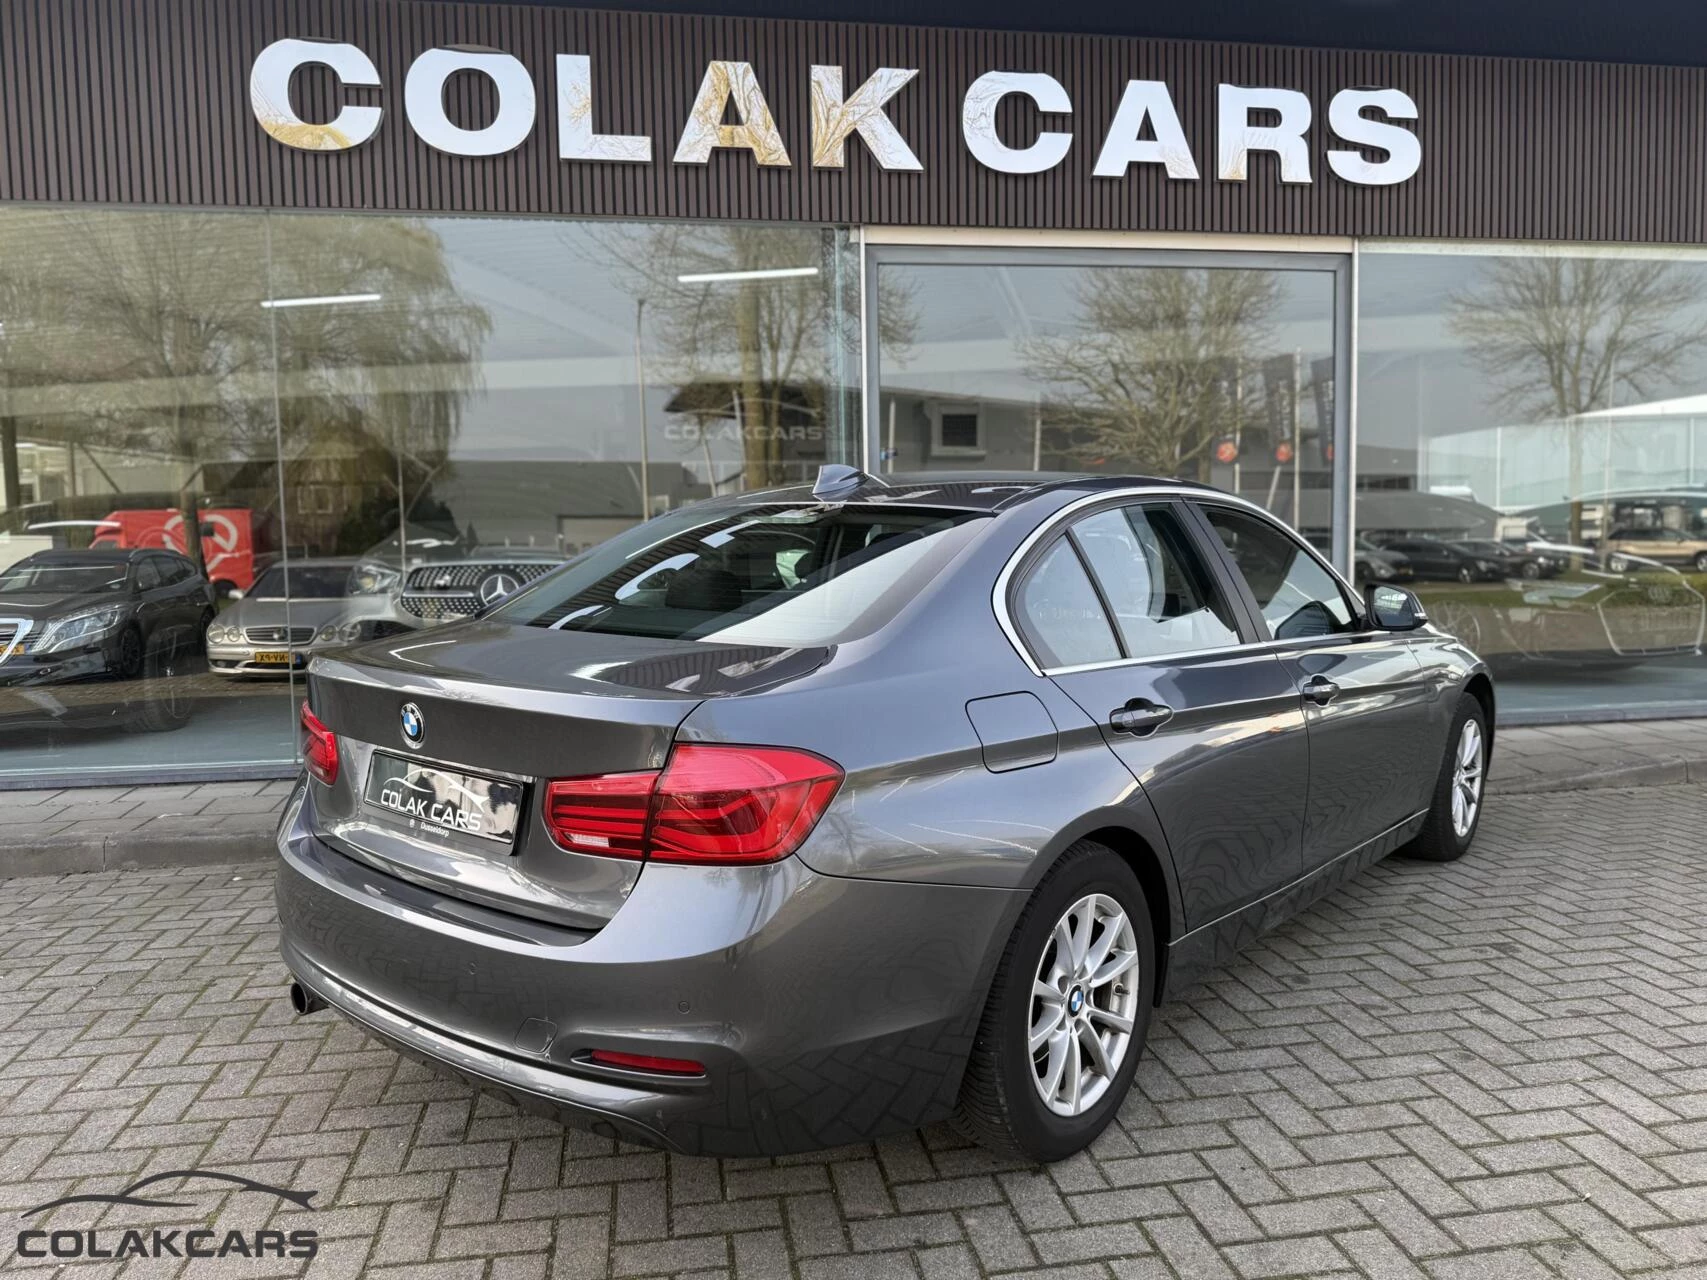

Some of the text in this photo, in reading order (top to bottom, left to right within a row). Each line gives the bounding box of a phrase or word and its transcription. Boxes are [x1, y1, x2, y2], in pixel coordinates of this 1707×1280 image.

[249, 37, 1422, 186] COLAK CARS
[380, 788, 483, 831] COLAK CARS
